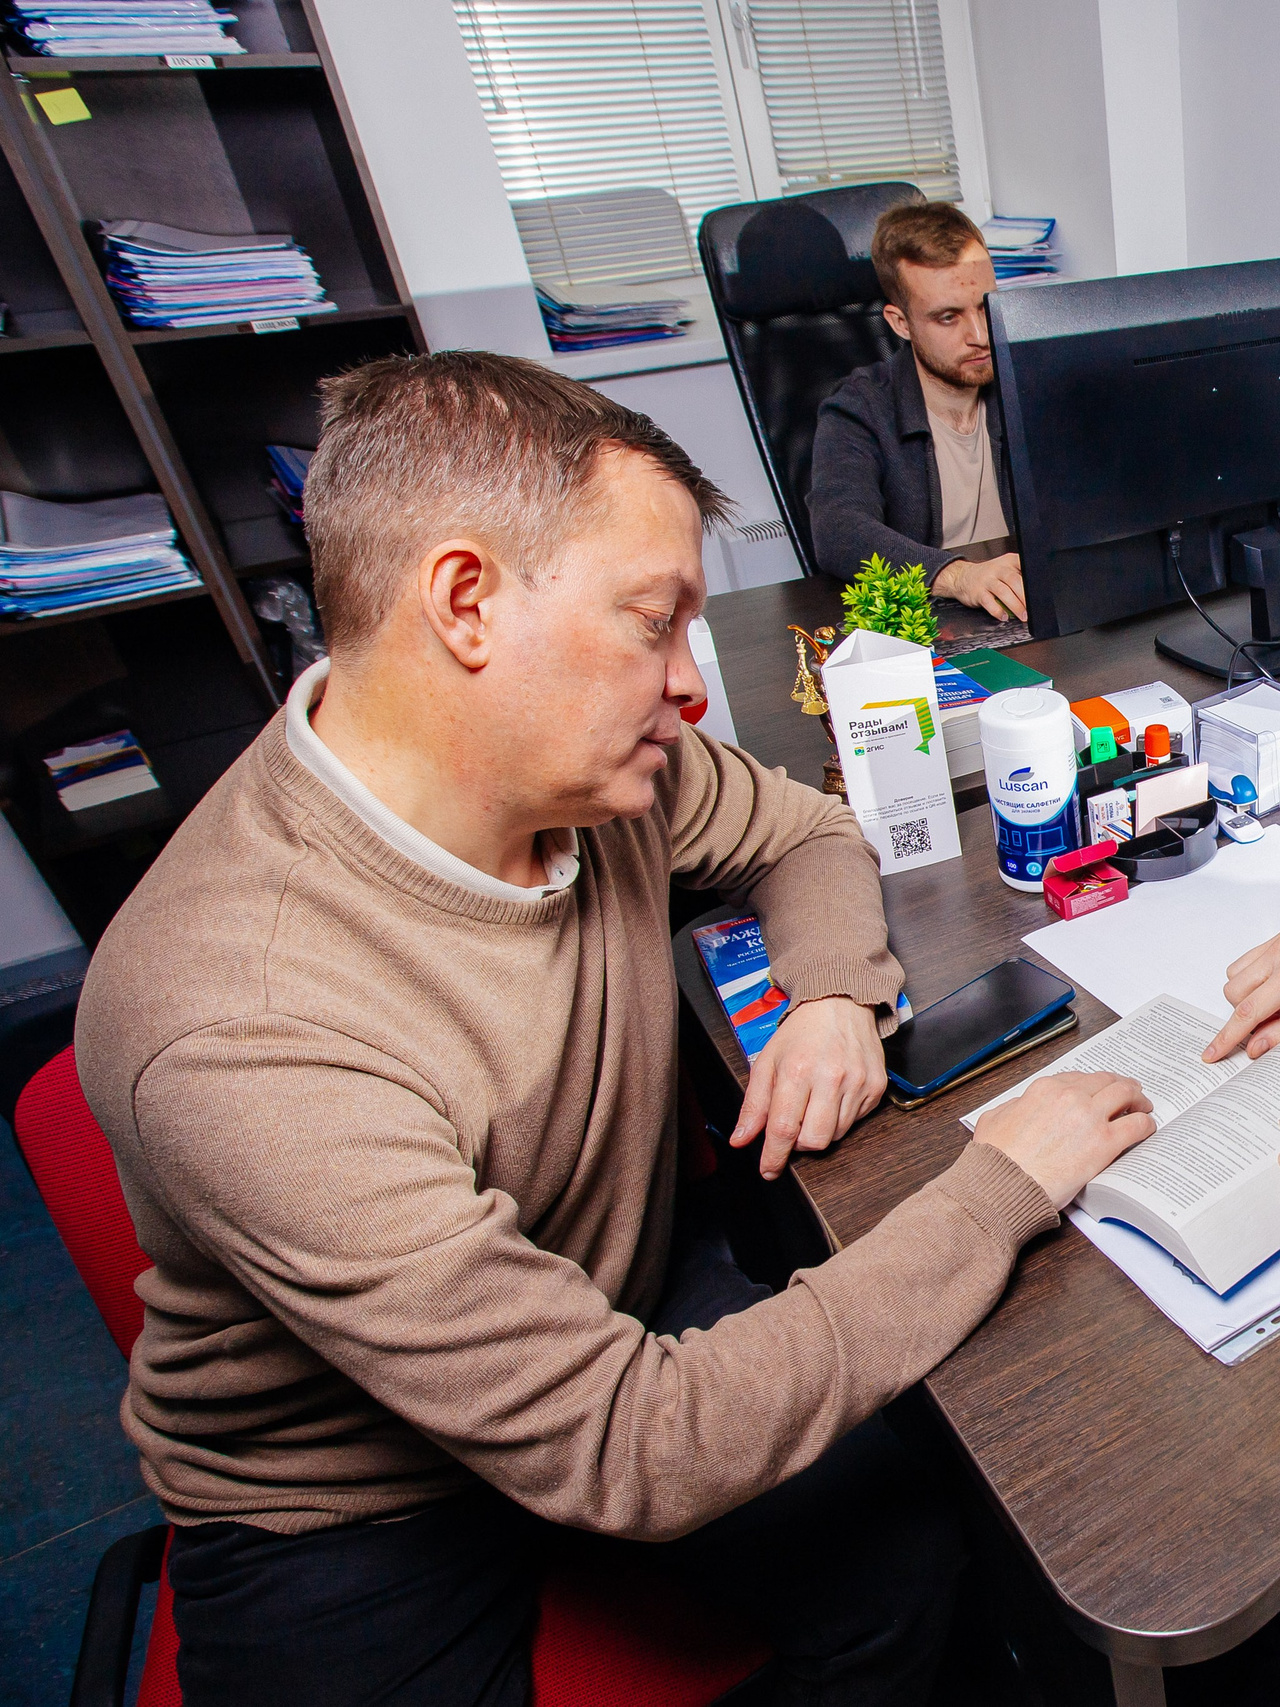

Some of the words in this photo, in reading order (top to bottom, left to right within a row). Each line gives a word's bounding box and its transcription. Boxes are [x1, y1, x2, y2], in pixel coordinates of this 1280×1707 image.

[849, 719, 882, 730] Рады
[851, 720, 908, 739] отзывам!
[866, 744, 885, 753] 2ГИС
[999, 779, 1049, 792] Luscan
[994, 797, 1025, 808] ЧИСТЯЩИЕ
[1026, 797, 1062, 809] САЛФЕТКИ
[1007, 861, 1017, 869] 100
